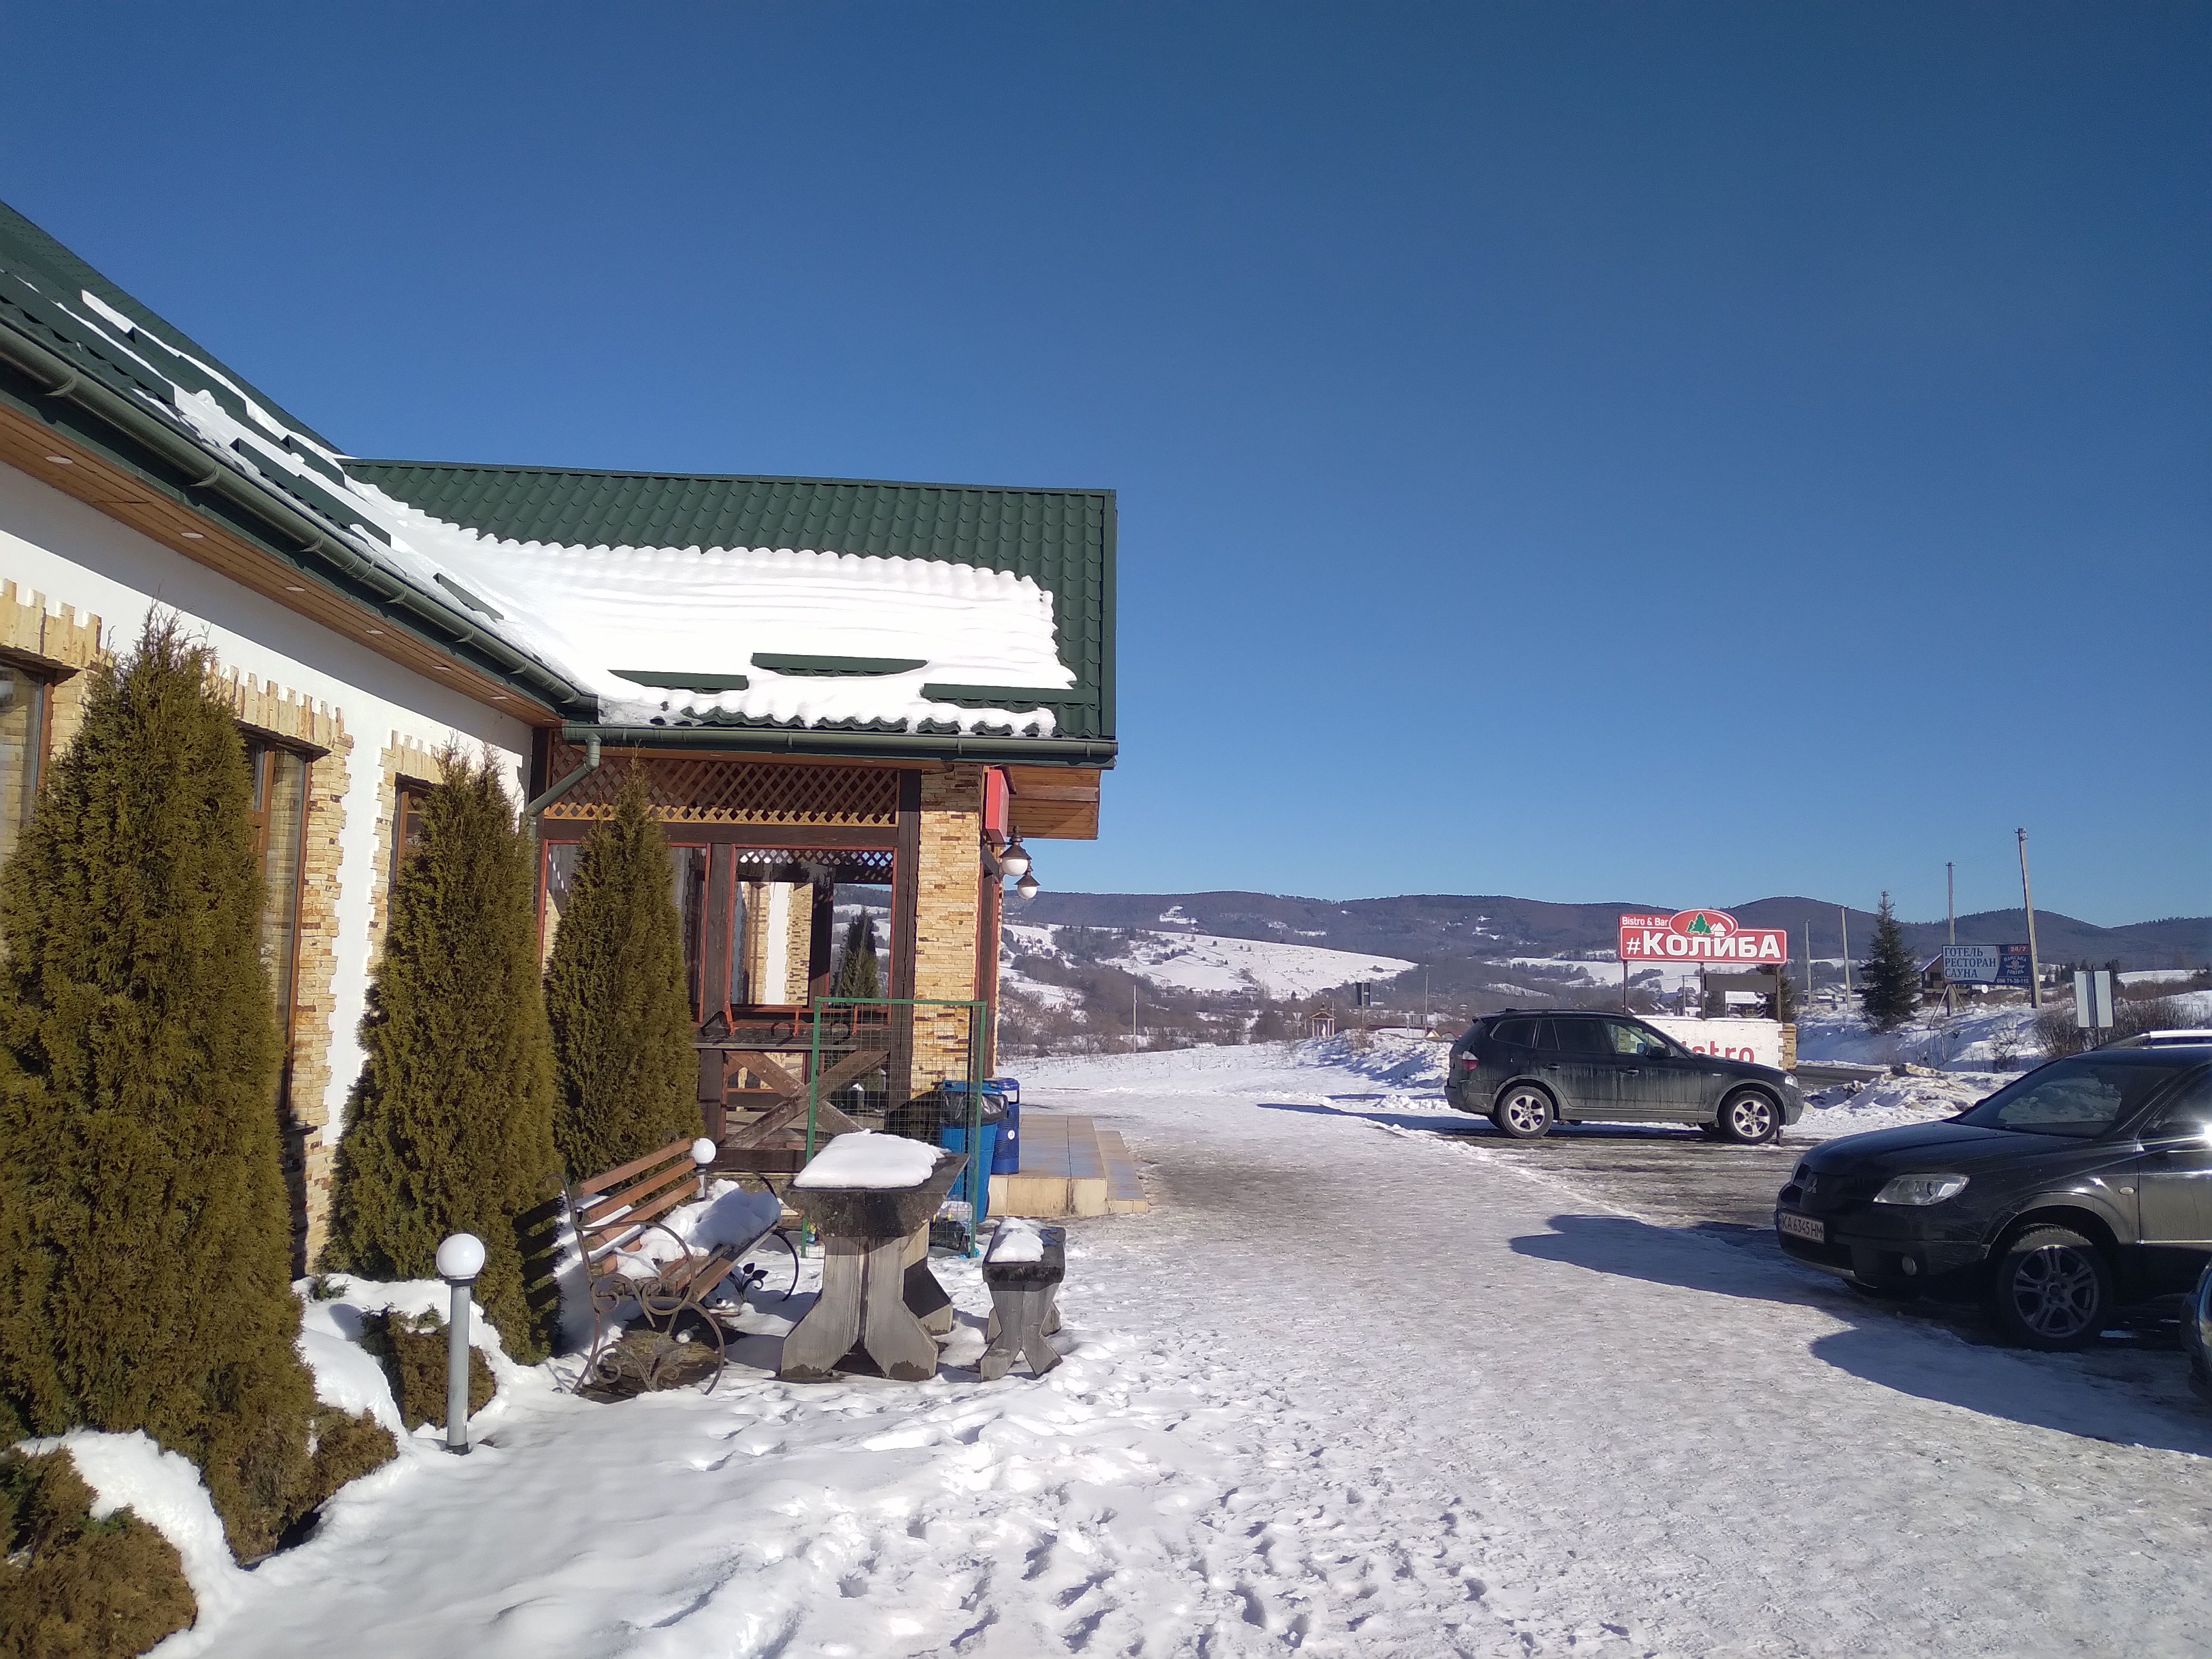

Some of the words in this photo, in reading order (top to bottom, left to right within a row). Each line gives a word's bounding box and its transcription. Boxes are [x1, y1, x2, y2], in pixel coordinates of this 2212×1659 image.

[1622, 916, 1645, 925] Bistro
[1647, 917, 1653, 926] &
[1655, 917, 1669, 926] Bar
[1945, 948, 1983, 957] ГОТЕЛЬ
[1945, 958, 1996, 967] РЕСТОРАН
[1945, 968, 1978, 978] САУНА
